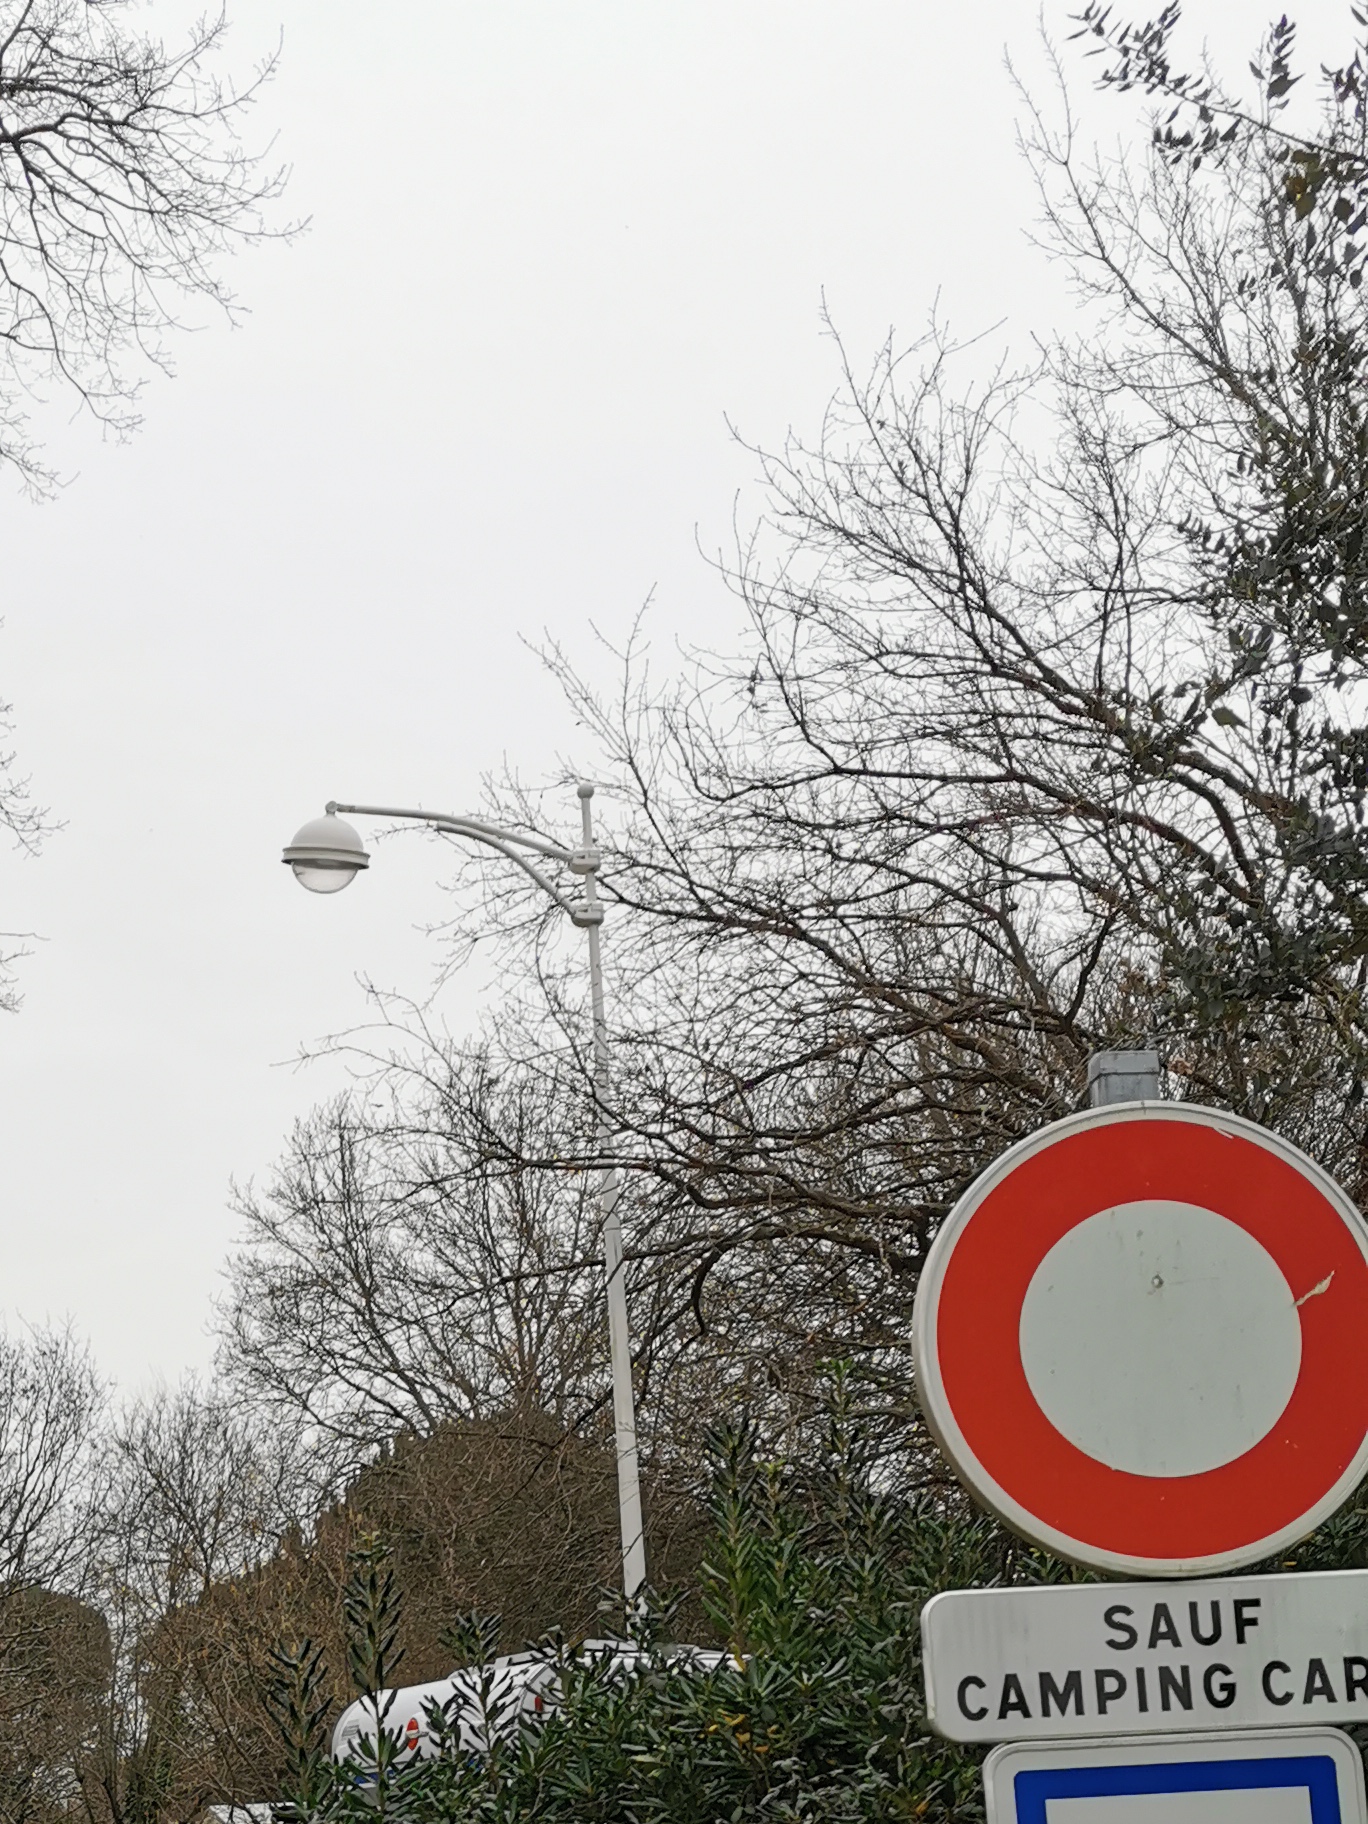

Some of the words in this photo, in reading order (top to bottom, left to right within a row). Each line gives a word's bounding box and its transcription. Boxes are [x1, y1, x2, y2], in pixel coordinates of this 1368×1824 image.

[1103, 1598, 1262, 1651] SAUF
[956, 1662, 1237, 1722] CAMPING
[1261, 1655, 1368, 1707] CAR
